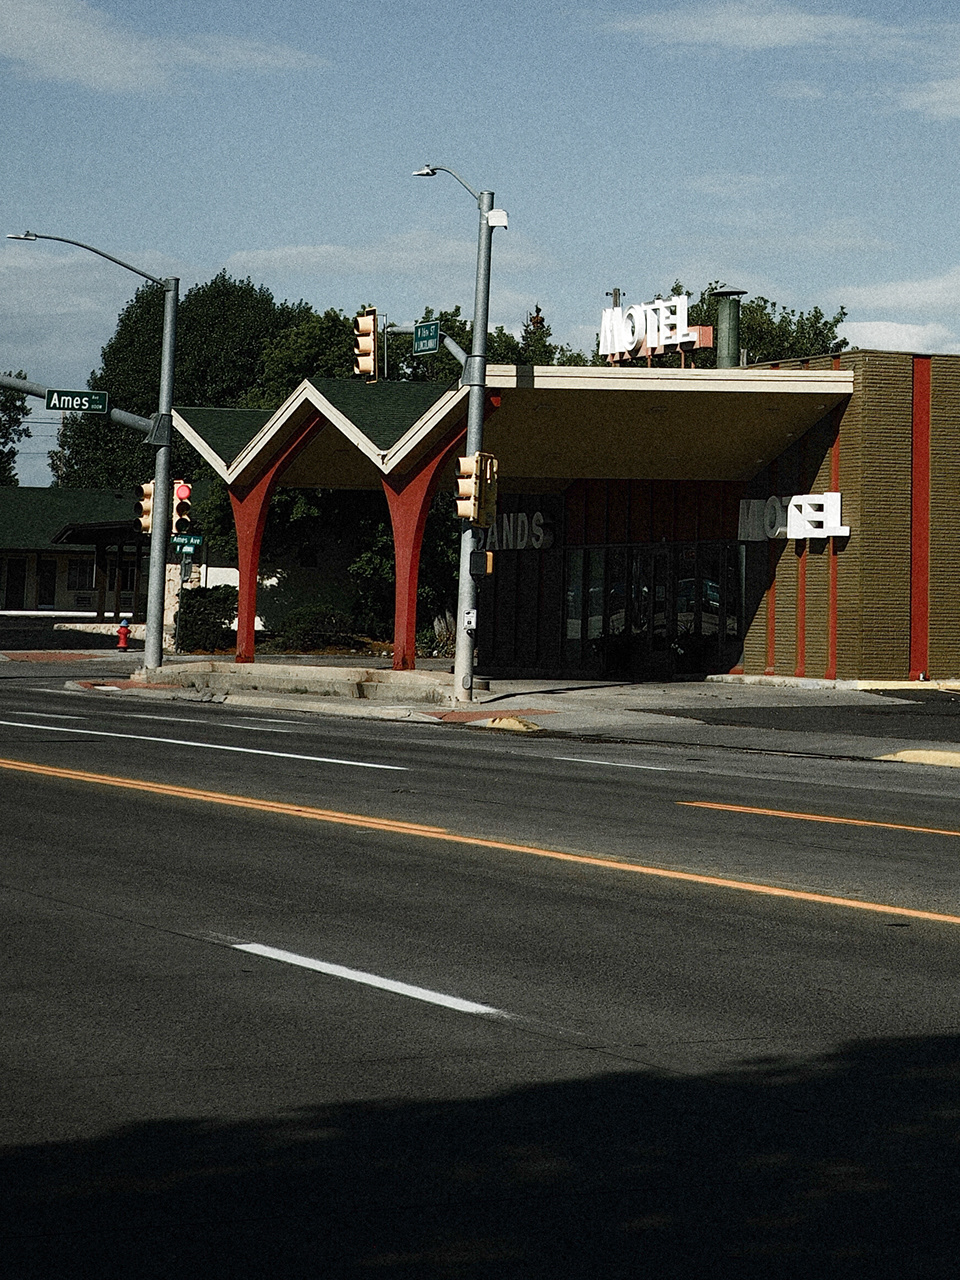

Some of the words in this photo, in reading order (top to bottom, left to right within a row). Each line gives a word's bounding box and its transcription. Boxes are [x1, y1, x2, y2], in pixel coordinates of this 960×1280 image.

[599, 295, 698, 355] MOTEL
[50, 392, 89, 410] Ames
[738, 492, 850, 541] MOTEL
